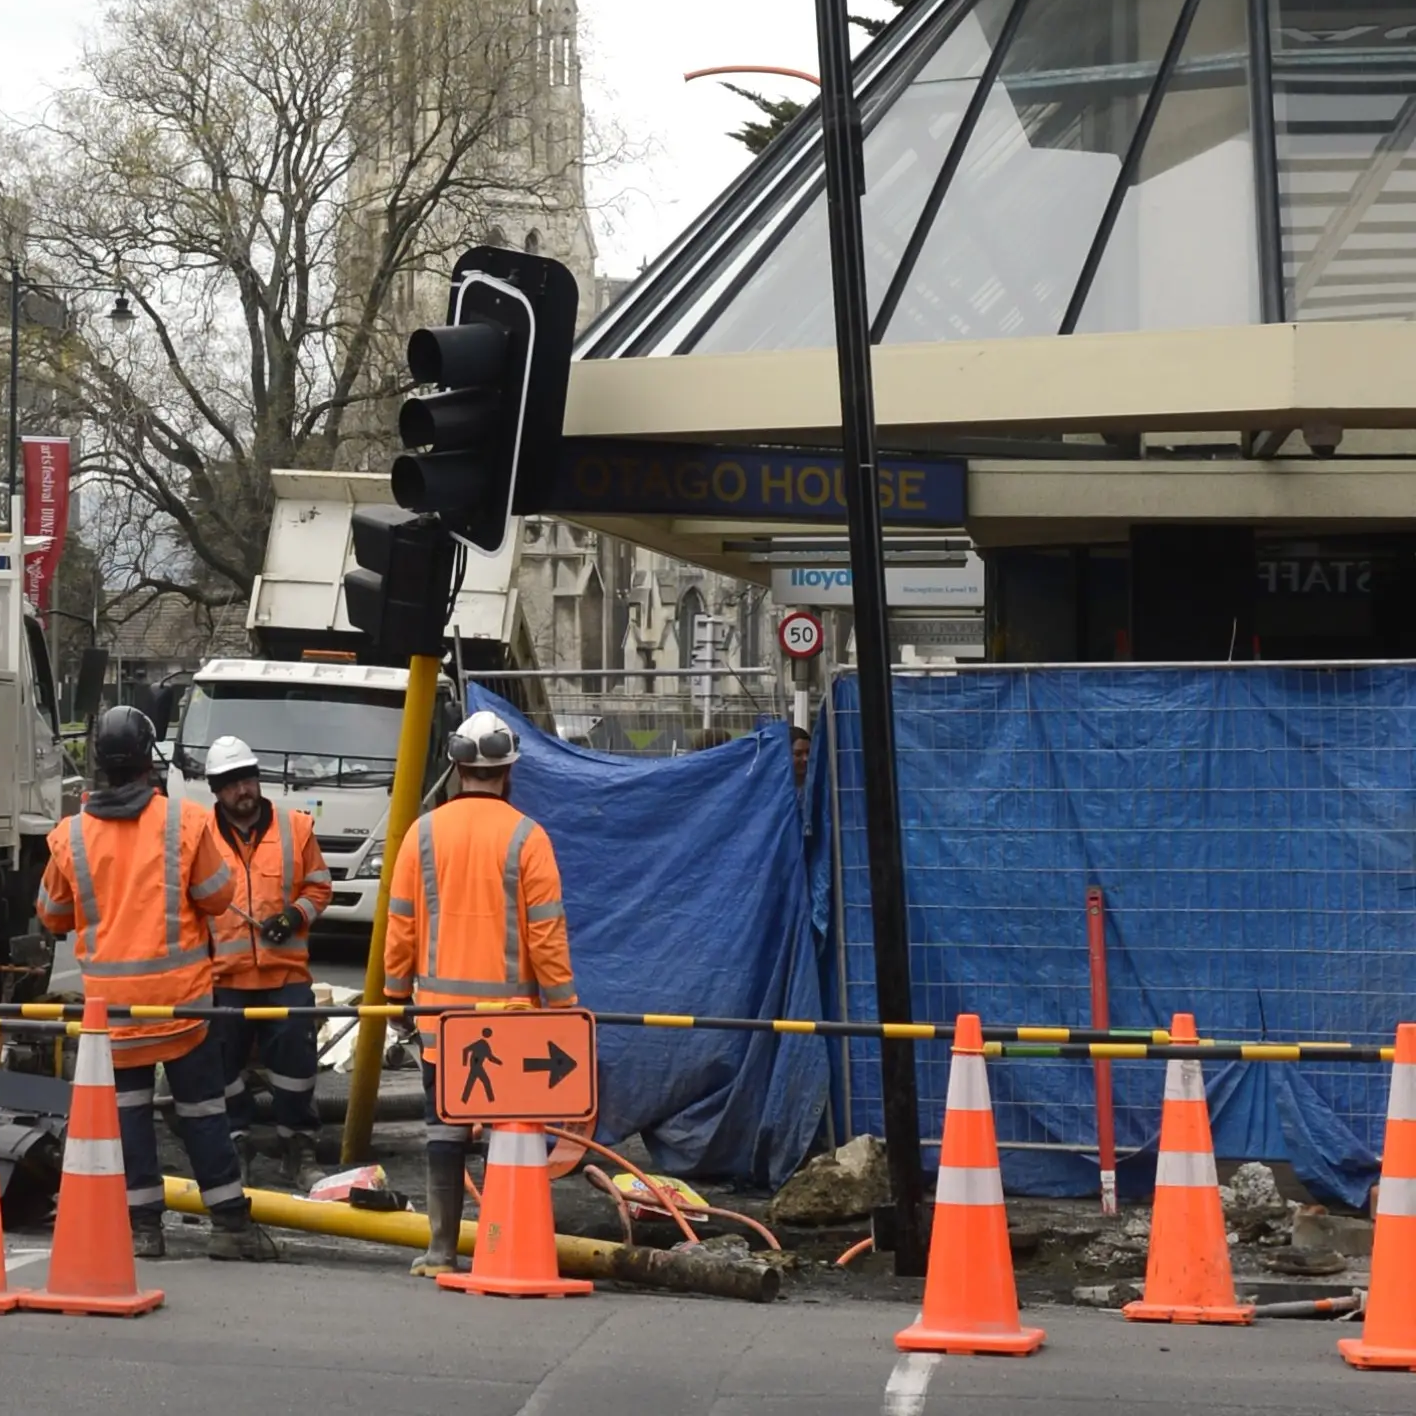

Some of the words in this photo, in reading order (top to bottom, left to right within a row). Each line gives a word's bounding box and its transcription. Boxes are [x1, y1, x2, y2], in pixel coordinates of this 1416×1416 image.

[576, 460, 746, 502] OTAGO
[39, 508, 55, 553] DUNEIN
[790, 627, 814, 644] 50
